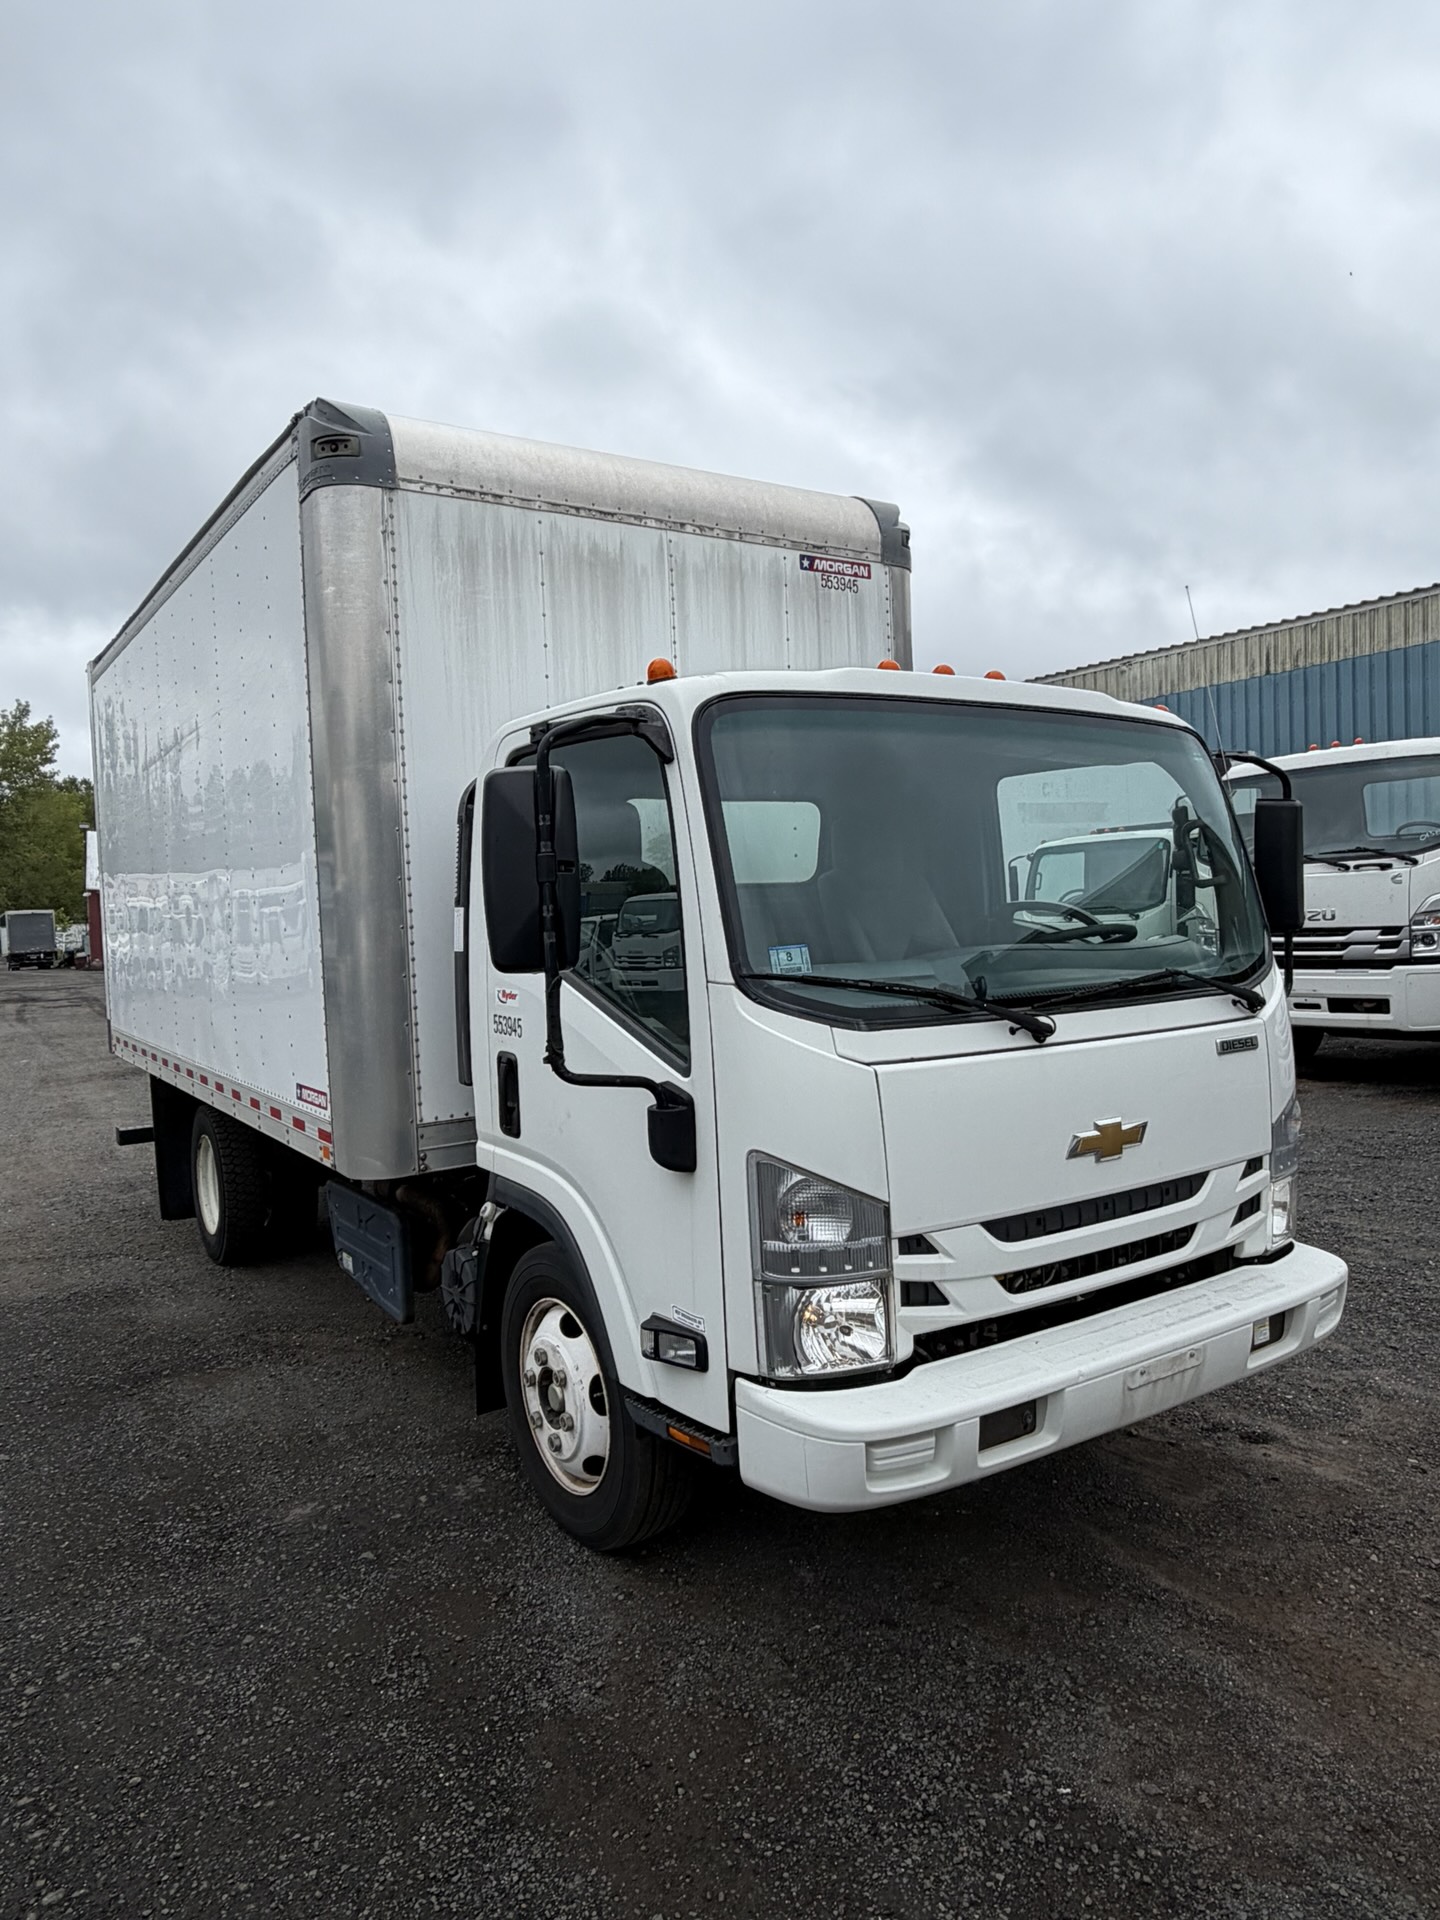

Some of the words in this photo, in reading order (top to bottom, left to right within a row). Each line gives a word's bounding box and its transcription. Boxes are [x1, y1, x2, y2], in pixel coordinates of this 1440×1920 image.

[813, 559, 869, 578] MORGAN
[821, 573, 859, 594] 553945
[1306, 908, 1336, 922] ZU
[786, 951, 793, 962] 8
[493, 1013, 523, 1039] 553945
[1221, 1036, 1257, 1052] DIESEL
